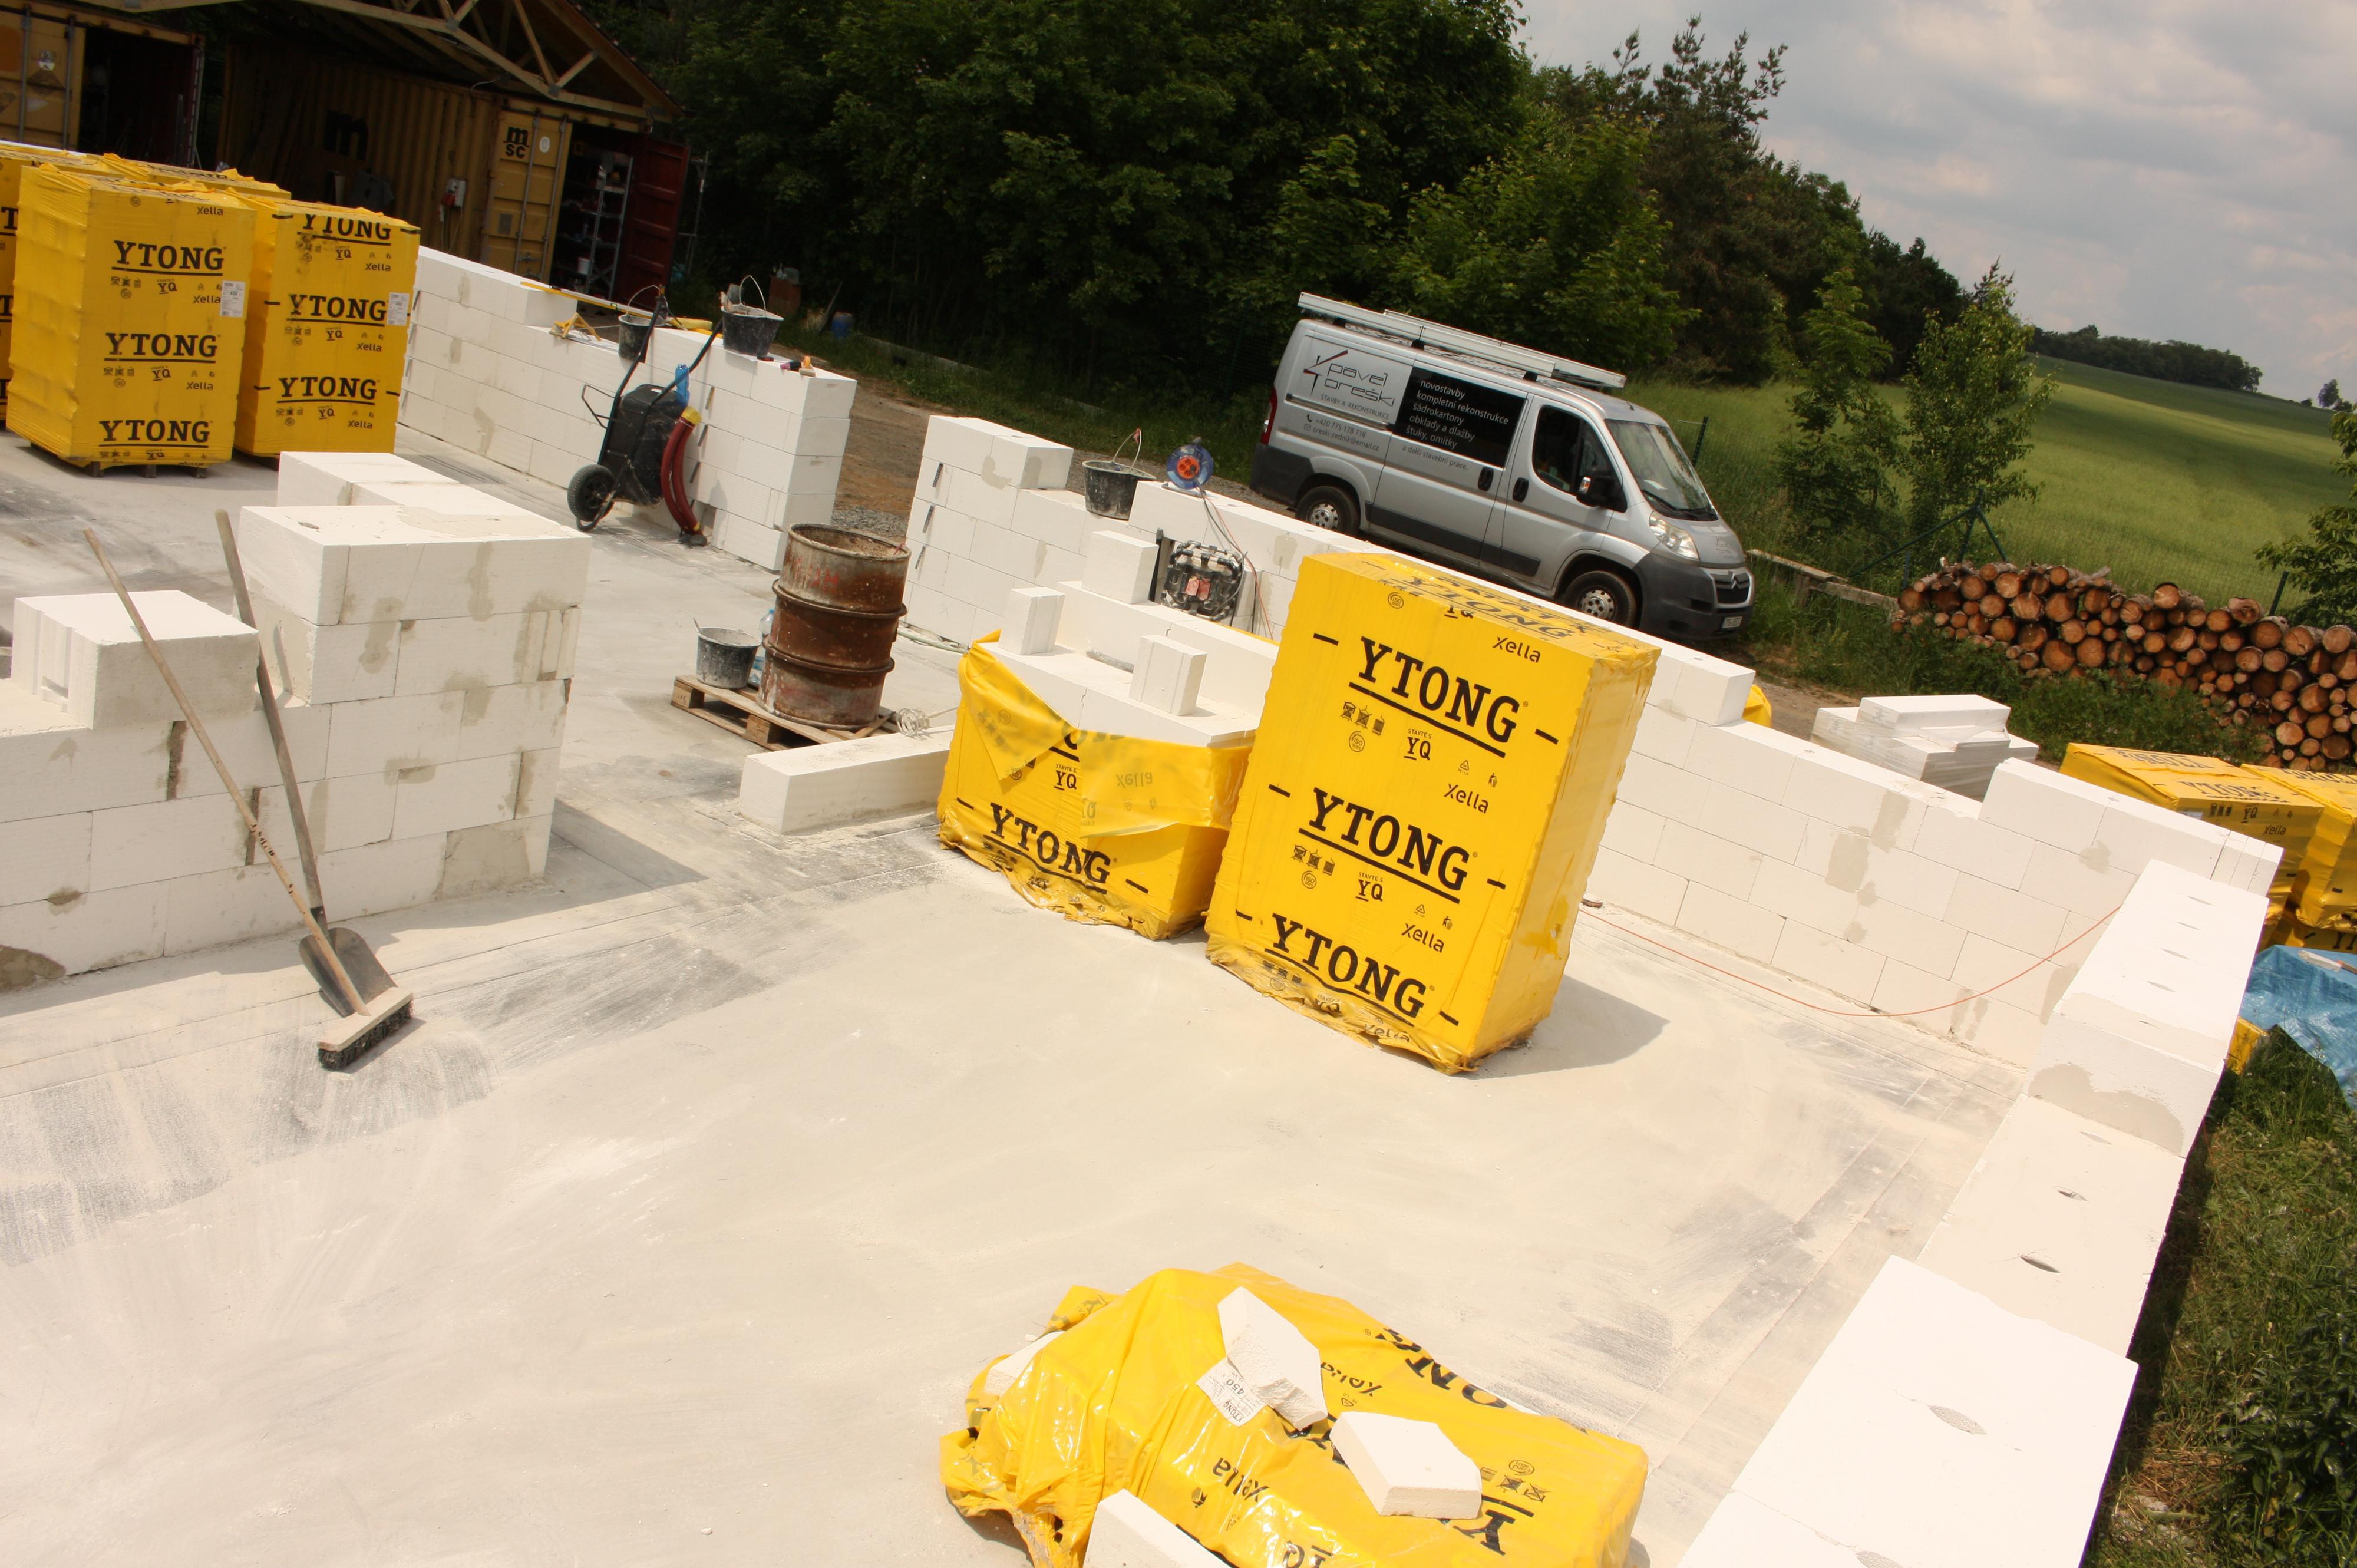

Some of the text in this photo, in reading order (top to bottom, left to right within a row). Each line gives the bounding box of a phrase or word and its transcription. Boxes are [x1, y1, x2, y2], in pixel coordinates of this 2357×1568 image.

[197, 206, 223, 216] Xella
[114, 240, 224, 270] YTONG
[365, 263, 391, 272] Xella
[193, 295, 221, 303] Xella
[289, 294, 387, 321] YTONG
[105, 332, 217, 358] YTONG
[356, 342, 382, 352] Xella
[186, 382, 213, 390] Xella
[1327, 363, 1388, 387] pavel
[279, 376, 377, 400] YTONG
[1421, 381, 1465, 400] novostavby
[1321, 394, 1339, 404] STAVBY
[1348, 402, 1389, 419] REKONSTRUKCE
[1413, 402, 1464, 425] sádrokartony
[1417, 390, 1508, 424] kompletní rekonstrukce
[99, 420, 210, 443] YTONG
[348, 420, 372, 429] Xella
[1409, 415, 1441, 431] obklady
[1448, 426, 1475, 442] dlažby
[1493, 636, 1541, 664] Xella
[1358, 636, 1520, 745] YTONG
[1407, 737, 1431, 760] YQ
[1056, 770, 1077, 789] YQ
[1444, 784, 1488, 814] Xella
[991, 802, 1110, 883] YTONG
[1308, 787, 1470, 892] YTONG
[2263, 826, 2286, 835] Xella
[1358, 879, 1383, 902] YQ
[1401, 923, 1444, 953] Xella
[1272, 913, 1426, 1019] YTONG
[1226, 1379, 1245, 1395] 450
[1223, 1401, 1243, 1422] YTONG
[1213, 1458, 1269, 1503] Xella
